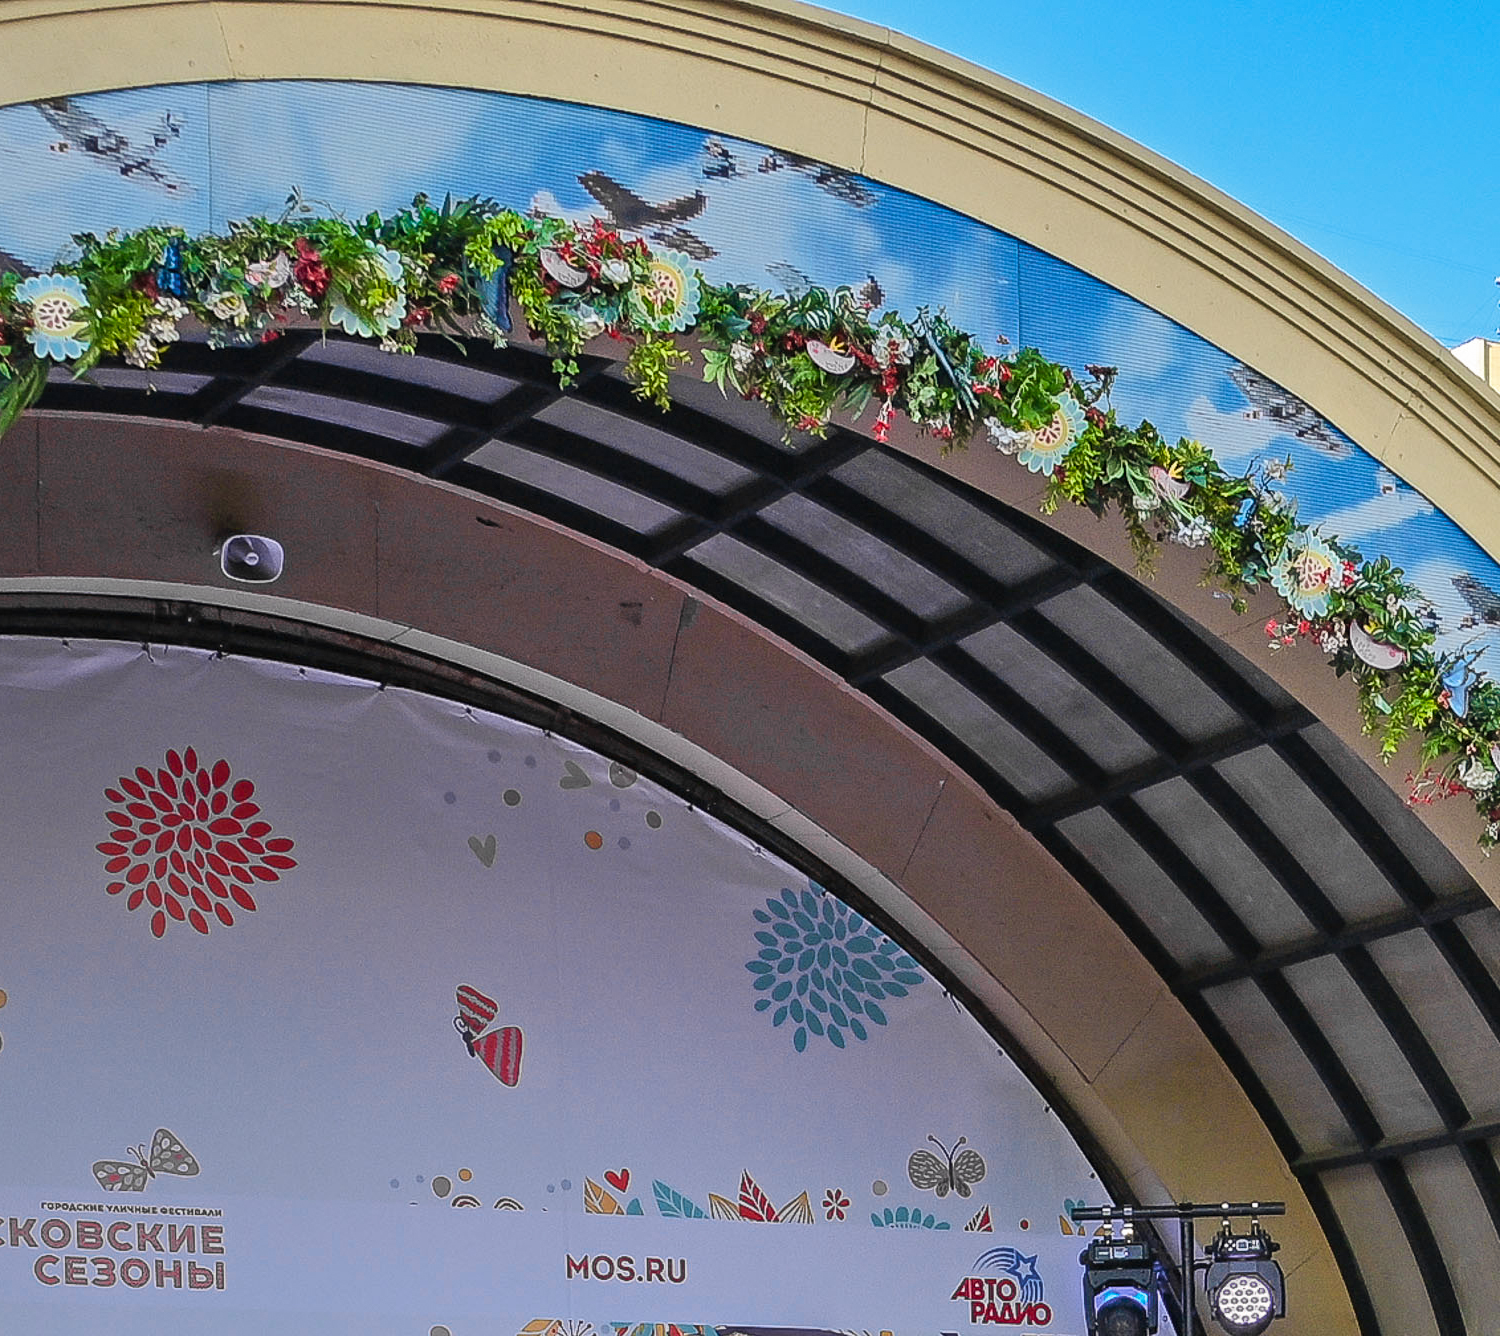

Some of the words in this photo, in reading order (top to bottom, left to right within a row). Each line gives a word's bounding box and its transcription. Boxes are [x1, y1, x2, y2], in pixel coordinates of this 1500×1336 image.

[40, 1202, 104, 1212] ГОРОДСКИЕ
[106, 1204, 158, 1214] УЛИЧНЫЕ
[160, 1207, 222, 1217] ФЕСТИВАЛИ
[33, 1254, 225, 1290] СЕЗОНЫ
[564, 1253, 688, 1284] MOS.RU
[950, 1277, 1017, 1302] АВТО
[970, 1301, 1052, 1326] РАДИО
